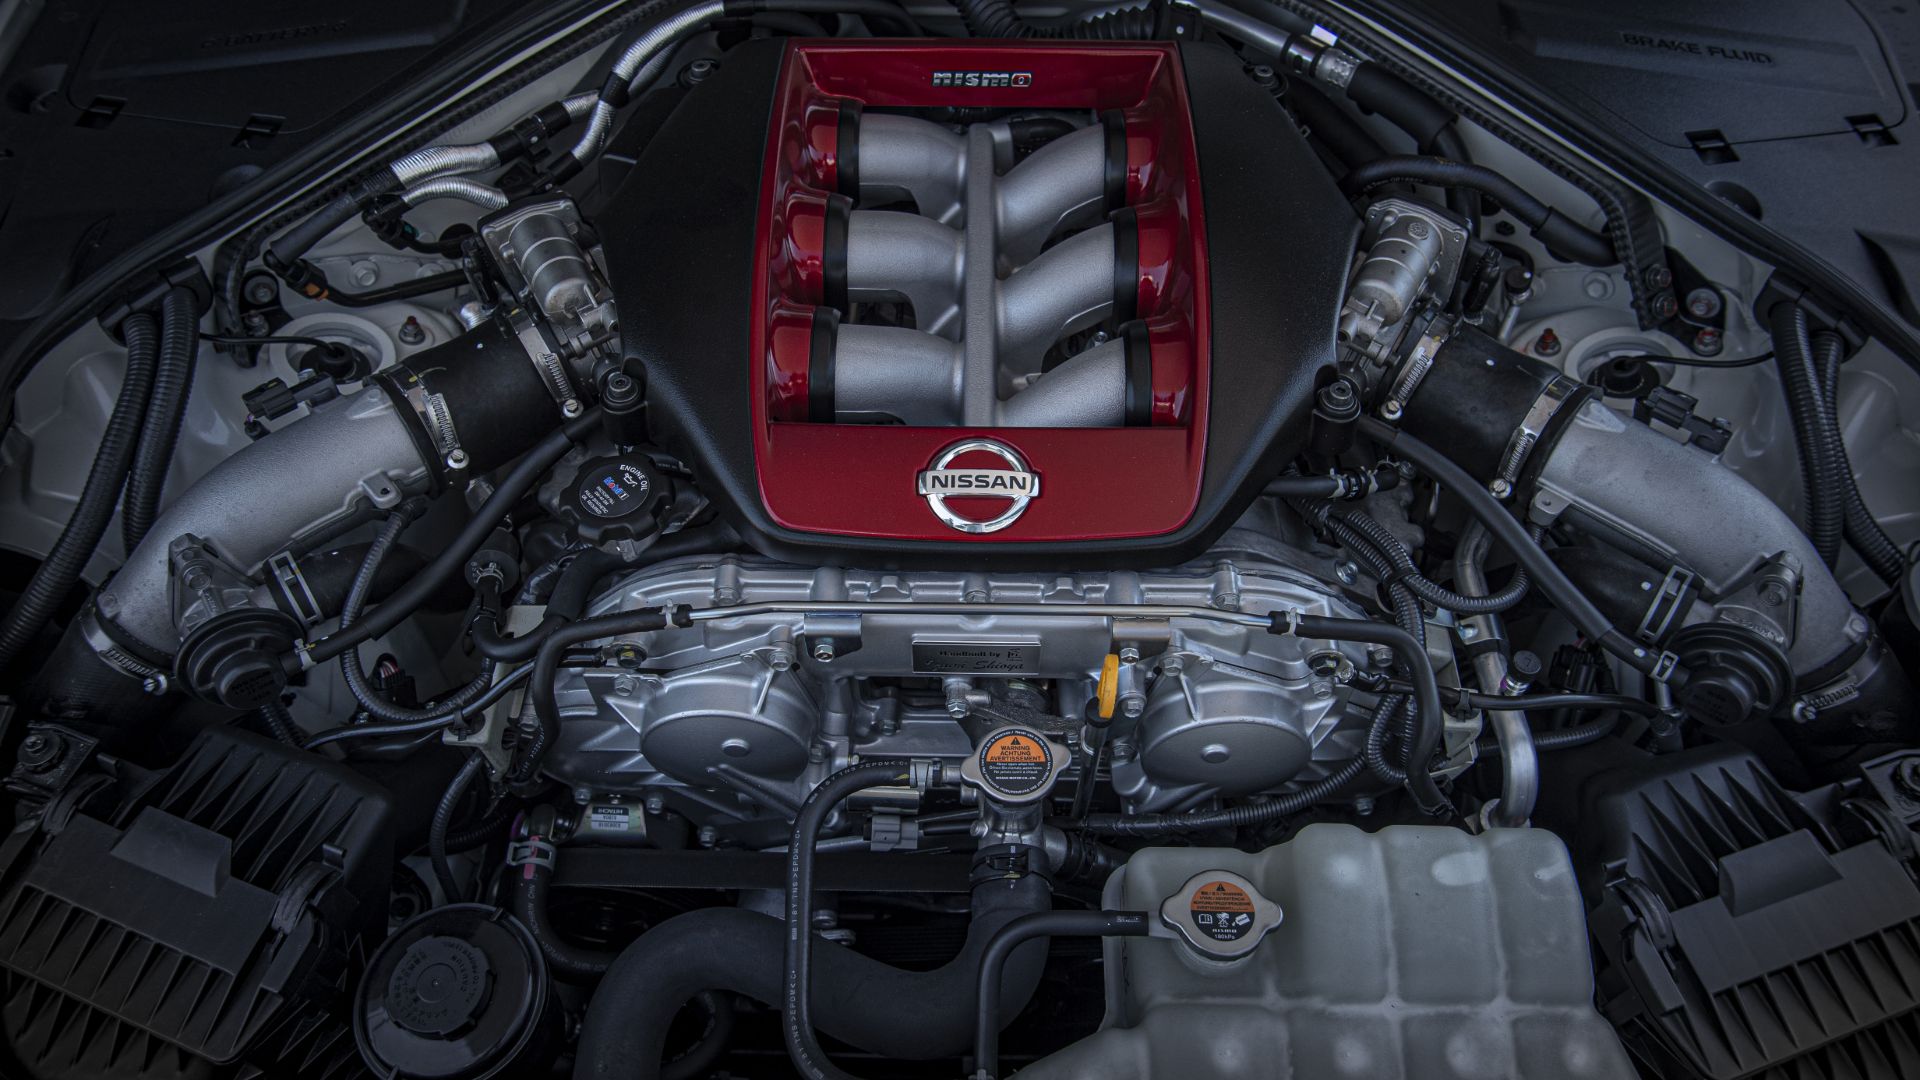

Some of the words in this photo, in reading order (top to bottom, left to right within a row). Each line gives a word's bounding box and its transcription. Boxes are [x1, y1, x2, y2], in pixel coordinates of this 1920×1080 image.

[1621, 33, 1702, 55] BRAKE
[1705, 45, 1773, 64] FLUID
[619, 464, 646, 481] ENGINE
[640, 480, 648, 491] OIL
[931, 474, 1027, 490] NISSAN
